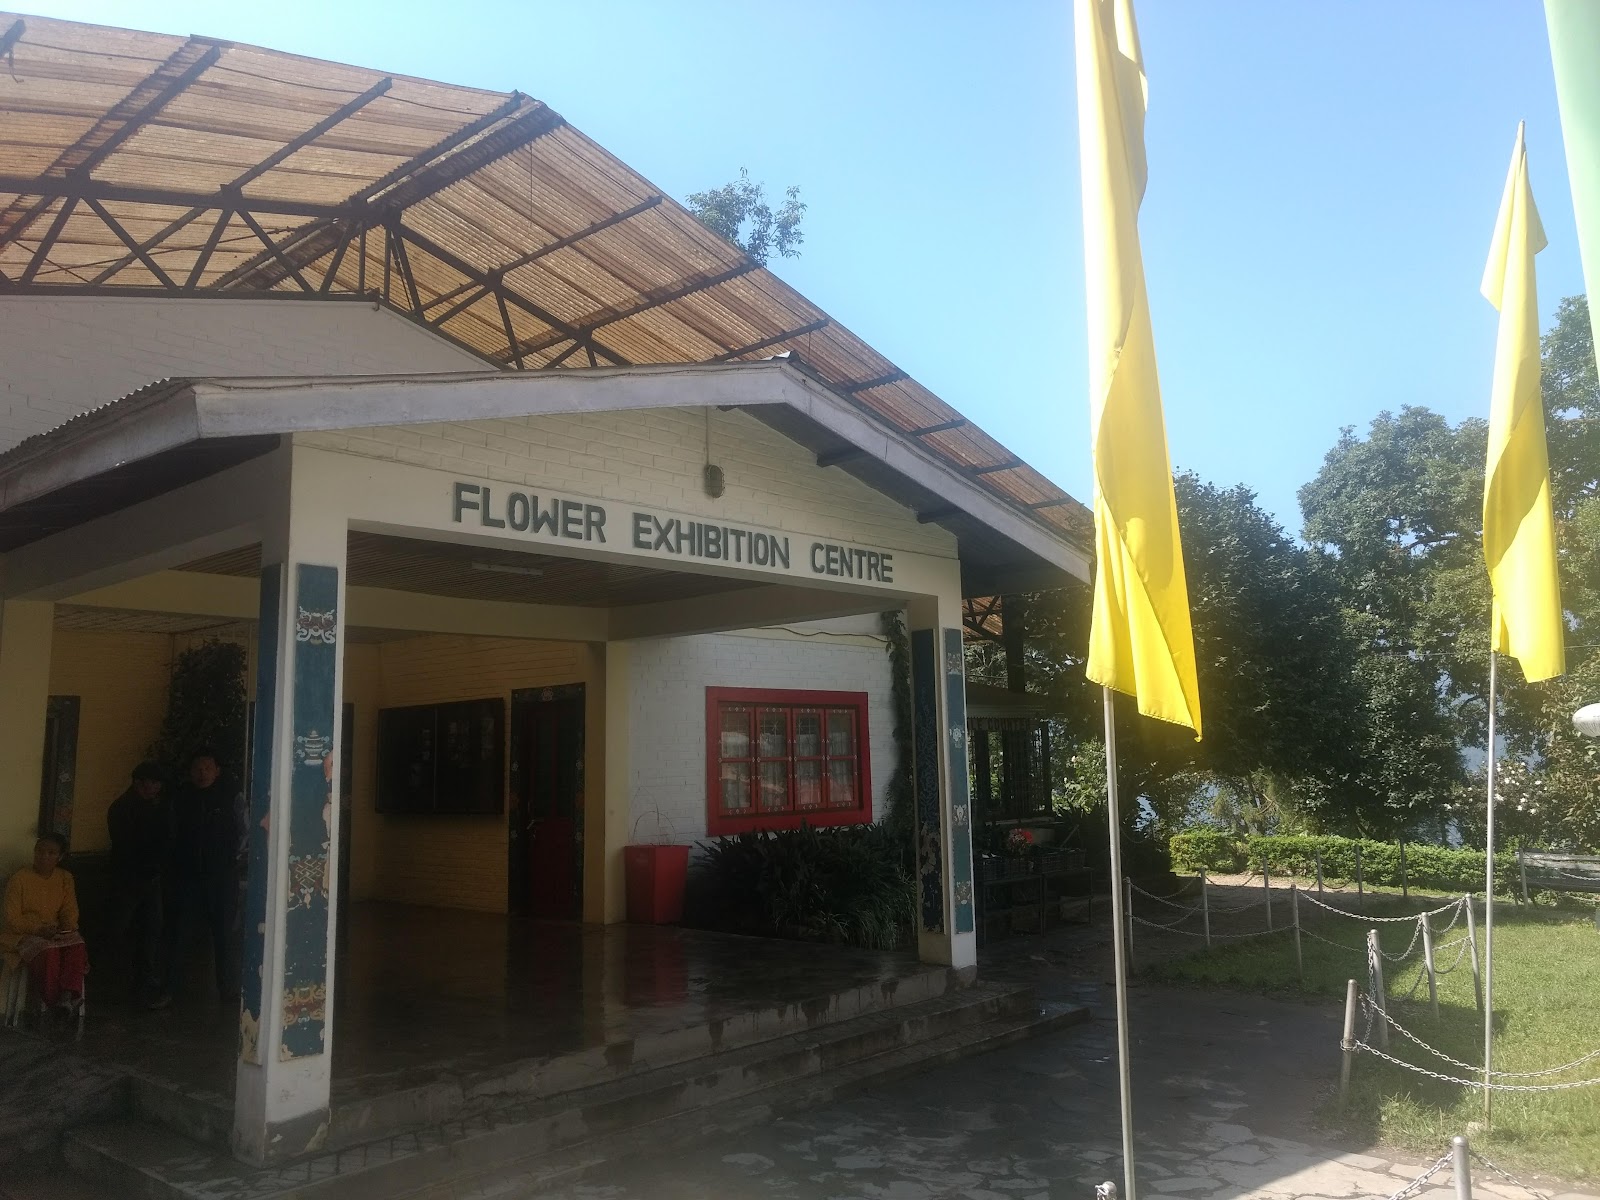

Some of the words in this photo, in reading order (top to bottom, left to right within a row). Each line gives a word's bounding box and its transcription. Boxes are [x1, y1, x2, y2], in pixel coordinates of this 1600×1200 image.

[453, 482, 607, 543] FLOWER
[633, 511, 790, 570] EXHIBITION
[810, 542, 894, 584] CENTRE
